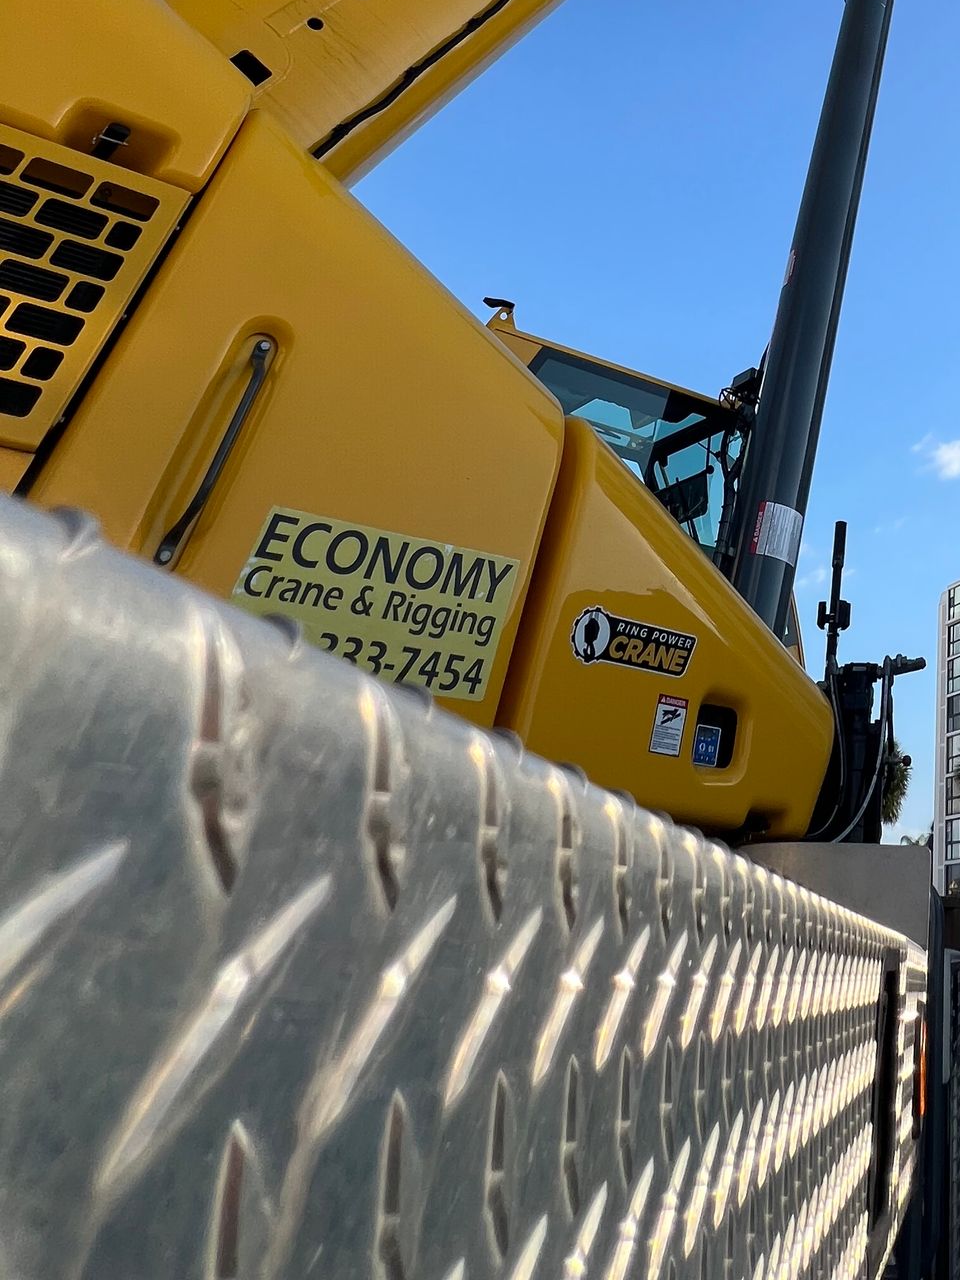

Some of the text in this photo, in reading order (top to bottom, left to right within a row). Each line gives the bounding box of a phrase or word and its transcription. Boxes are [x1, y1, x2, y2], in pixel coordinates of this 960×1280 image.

[254, 513, 513, 603] ECONOMY
[243, 566, 496, 646] Crane & Rigging
[609, 635, 688, 672] CRANE
[617, 623, 691, 648] RING POWER
